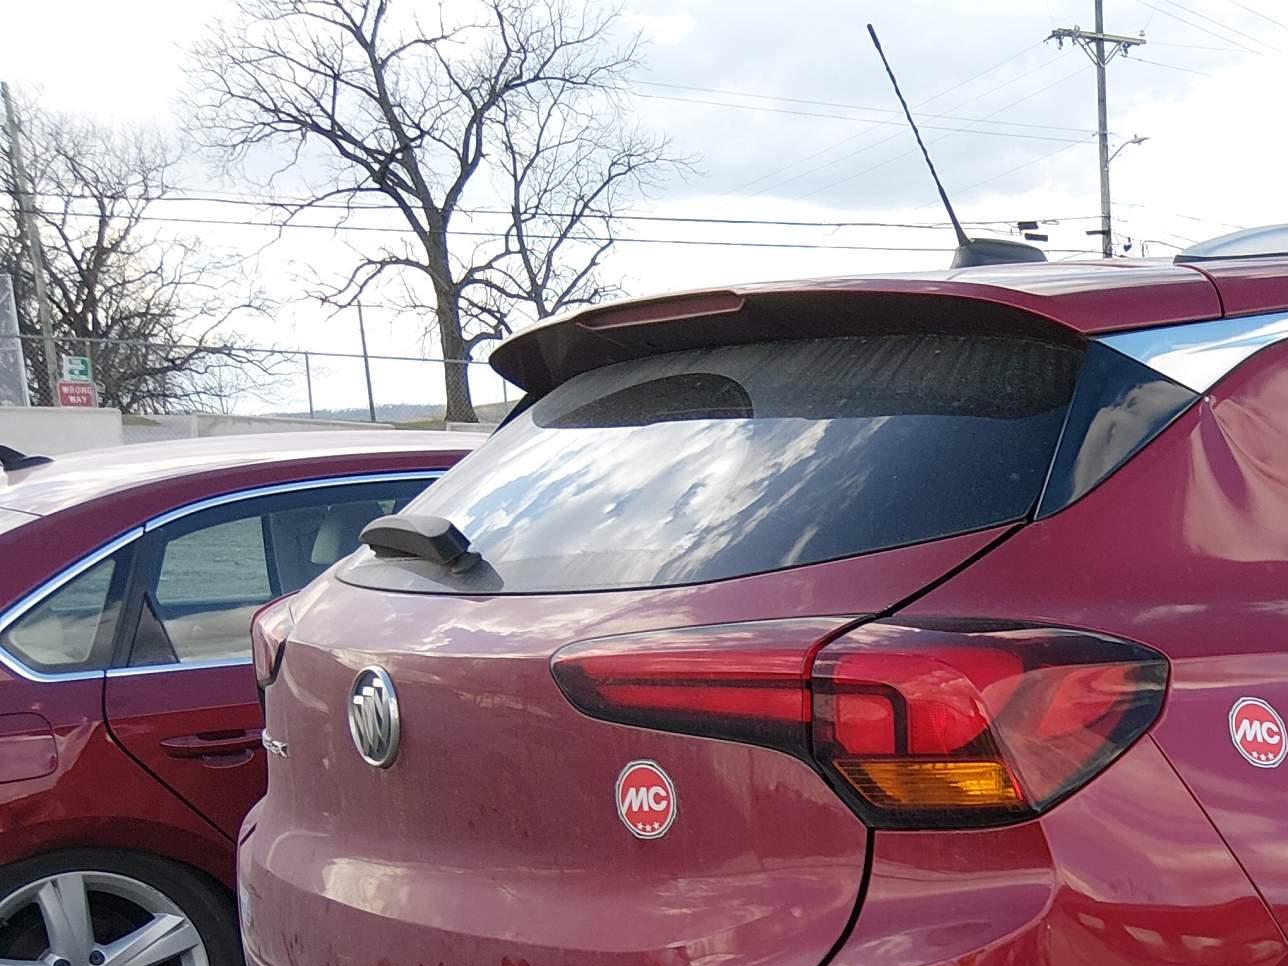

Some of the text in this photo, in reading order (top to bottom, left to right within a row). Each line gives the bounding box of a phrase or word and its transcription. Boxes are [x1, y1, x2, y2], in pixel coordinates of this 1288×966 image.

[61, 386, 92, 394] WRONG
[68, 395, 87, 403] WAY
[1236, 719, 1281, 745] MC
[621, 786, 668, 814] MC
